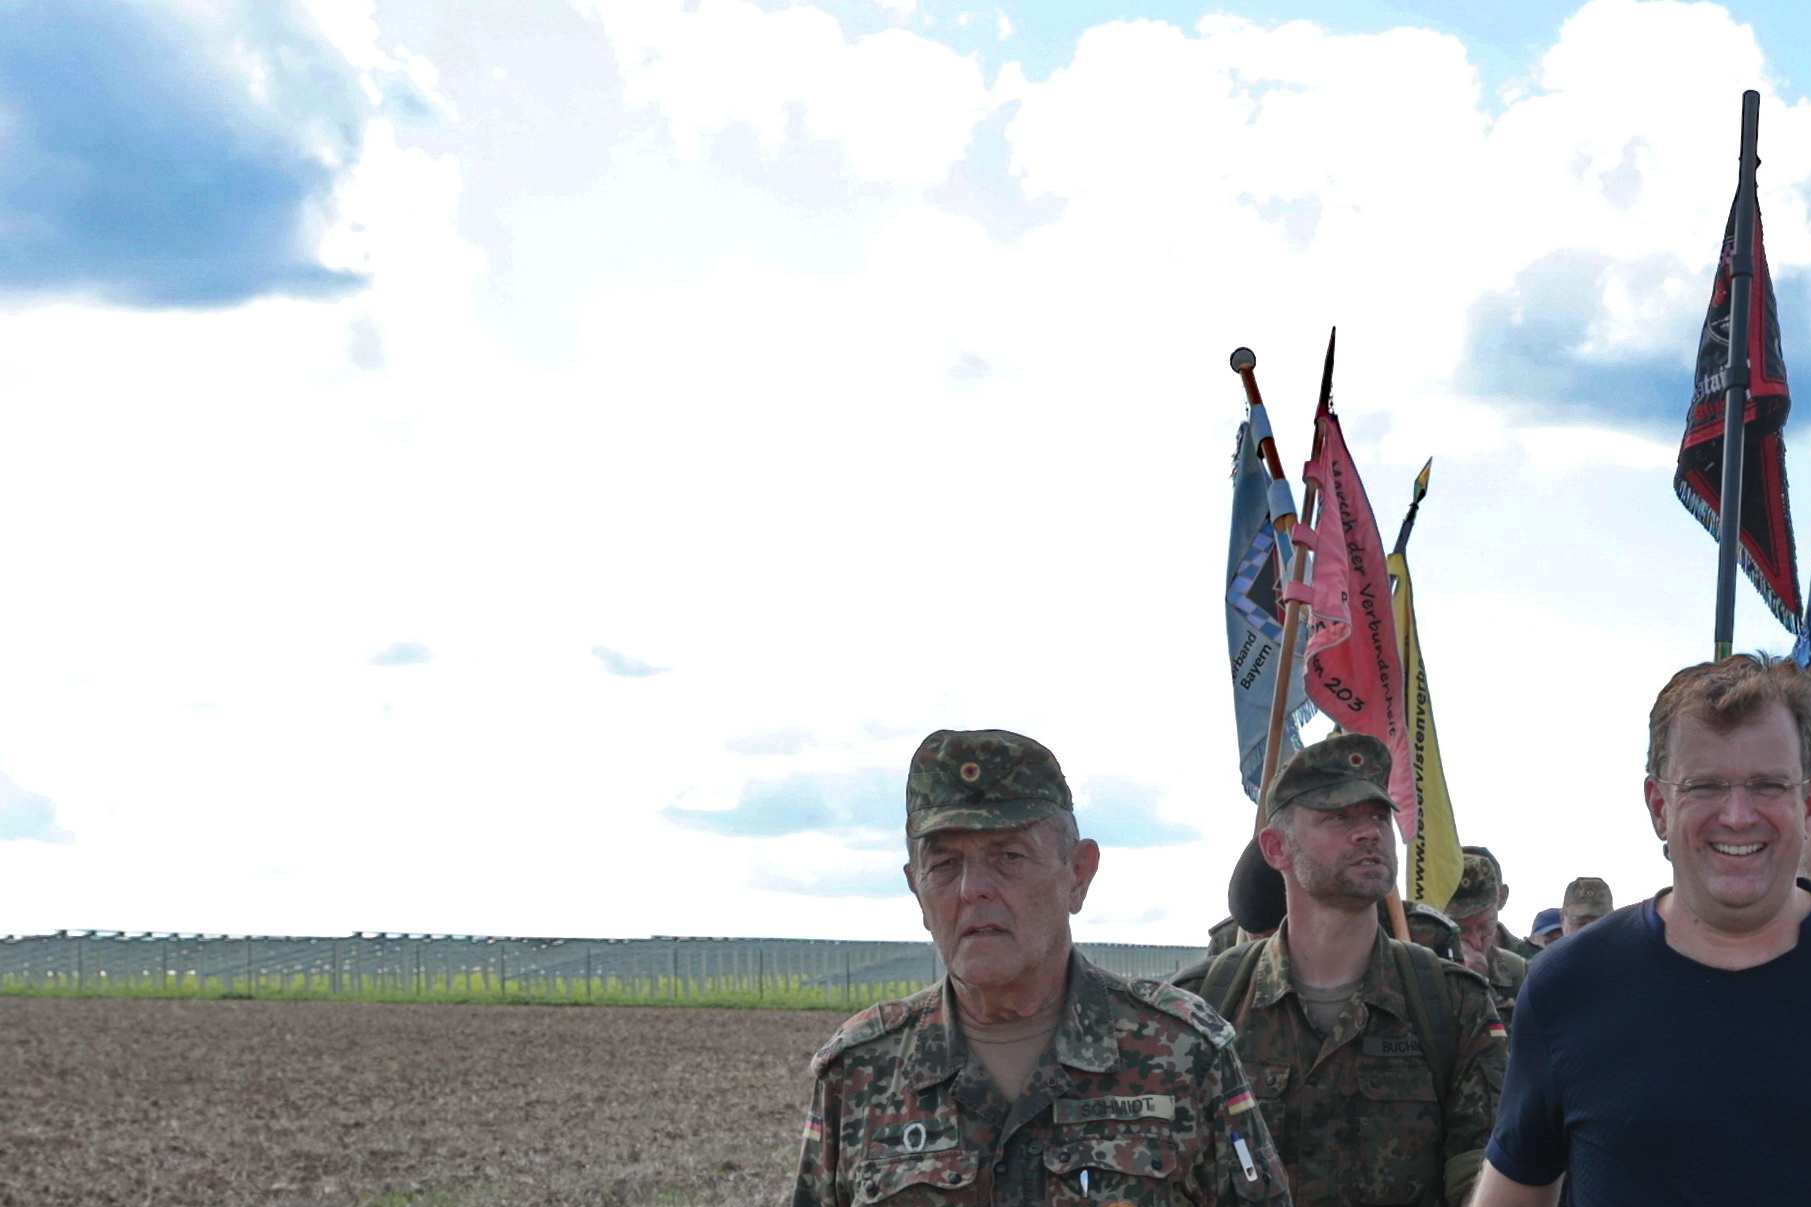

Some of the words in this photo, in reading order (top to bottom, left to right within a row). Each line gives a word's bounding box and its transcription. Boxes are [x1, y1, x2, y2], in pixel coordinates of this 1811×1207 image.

[1231, 629, 1257, 685] erband
[1347, 541, 1366, 578] der
[1358, 582, 1397, 737] Verbundenheit
[1240, 643, 1273, 690] Bayern
[1323, 676, 1366, 713] 203
[1081, 1096, 1154, 1118] SCHMIDT
